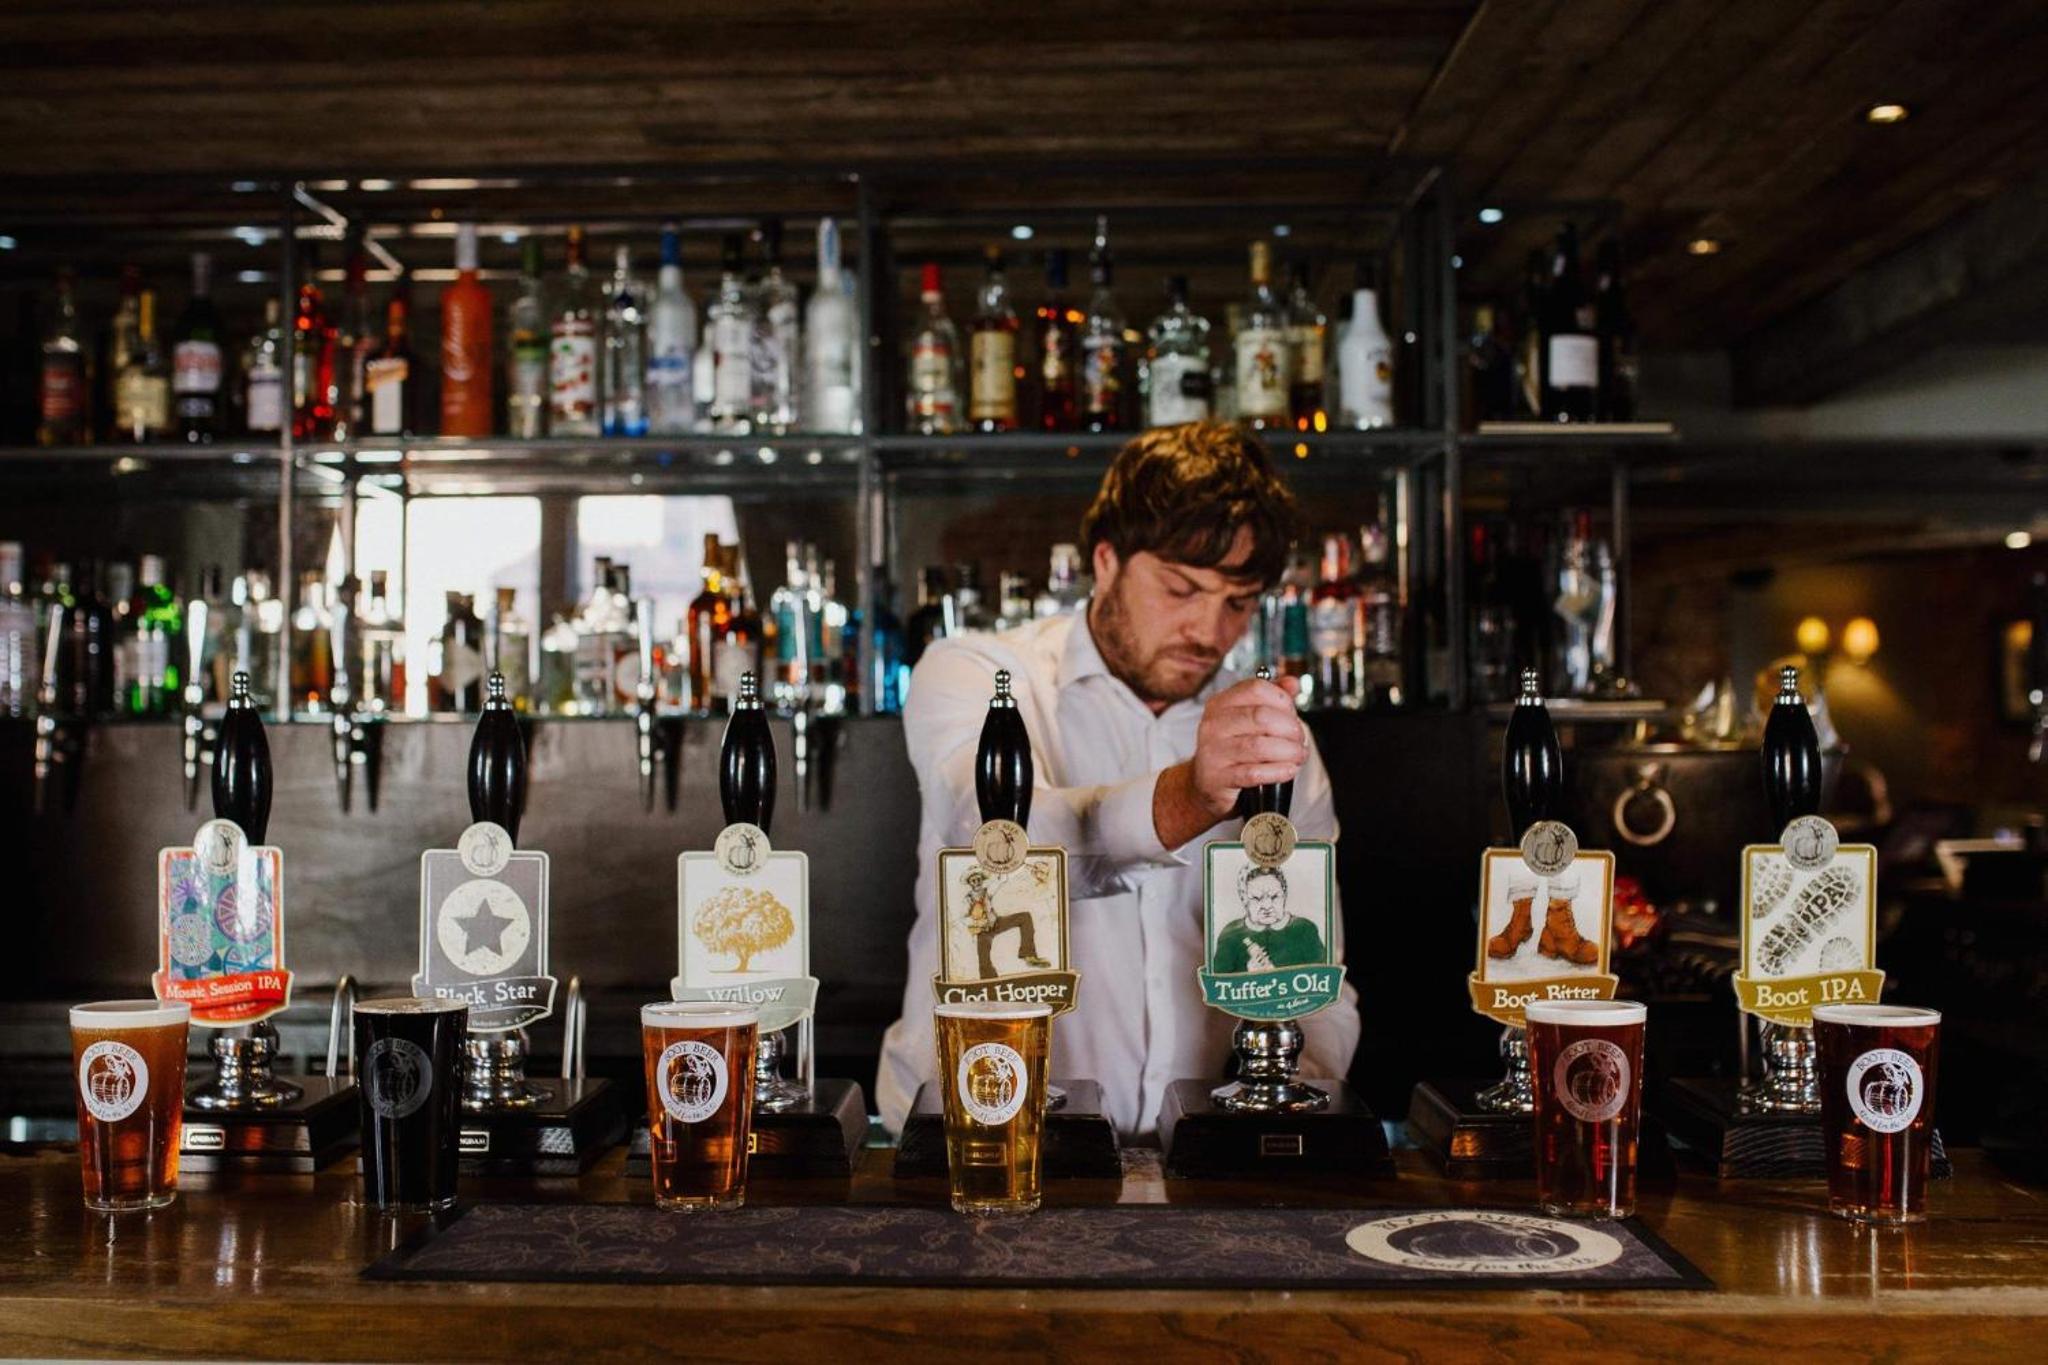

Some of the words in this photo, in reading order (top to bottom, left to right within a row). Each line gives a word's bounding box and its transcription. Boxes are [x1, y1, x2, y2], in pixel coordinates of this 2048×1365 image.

[209, 980, 253, 997] Session
[258, 976, 282, 990] IPA
[494, 981, 537, 1001] Star
[994, 983, 1068, 1003] Hopper
[1215, 979, 1288, 1000] Tuffer's
[1293, 973, 1330, 993] Old
[1492, 988, 1539, 1008] Boot
[1546, 984, 1600, 1000] Bitter
[1755, 985, 1809, 1007] Boot
[1819, 978, 1865, 1002] IPA
